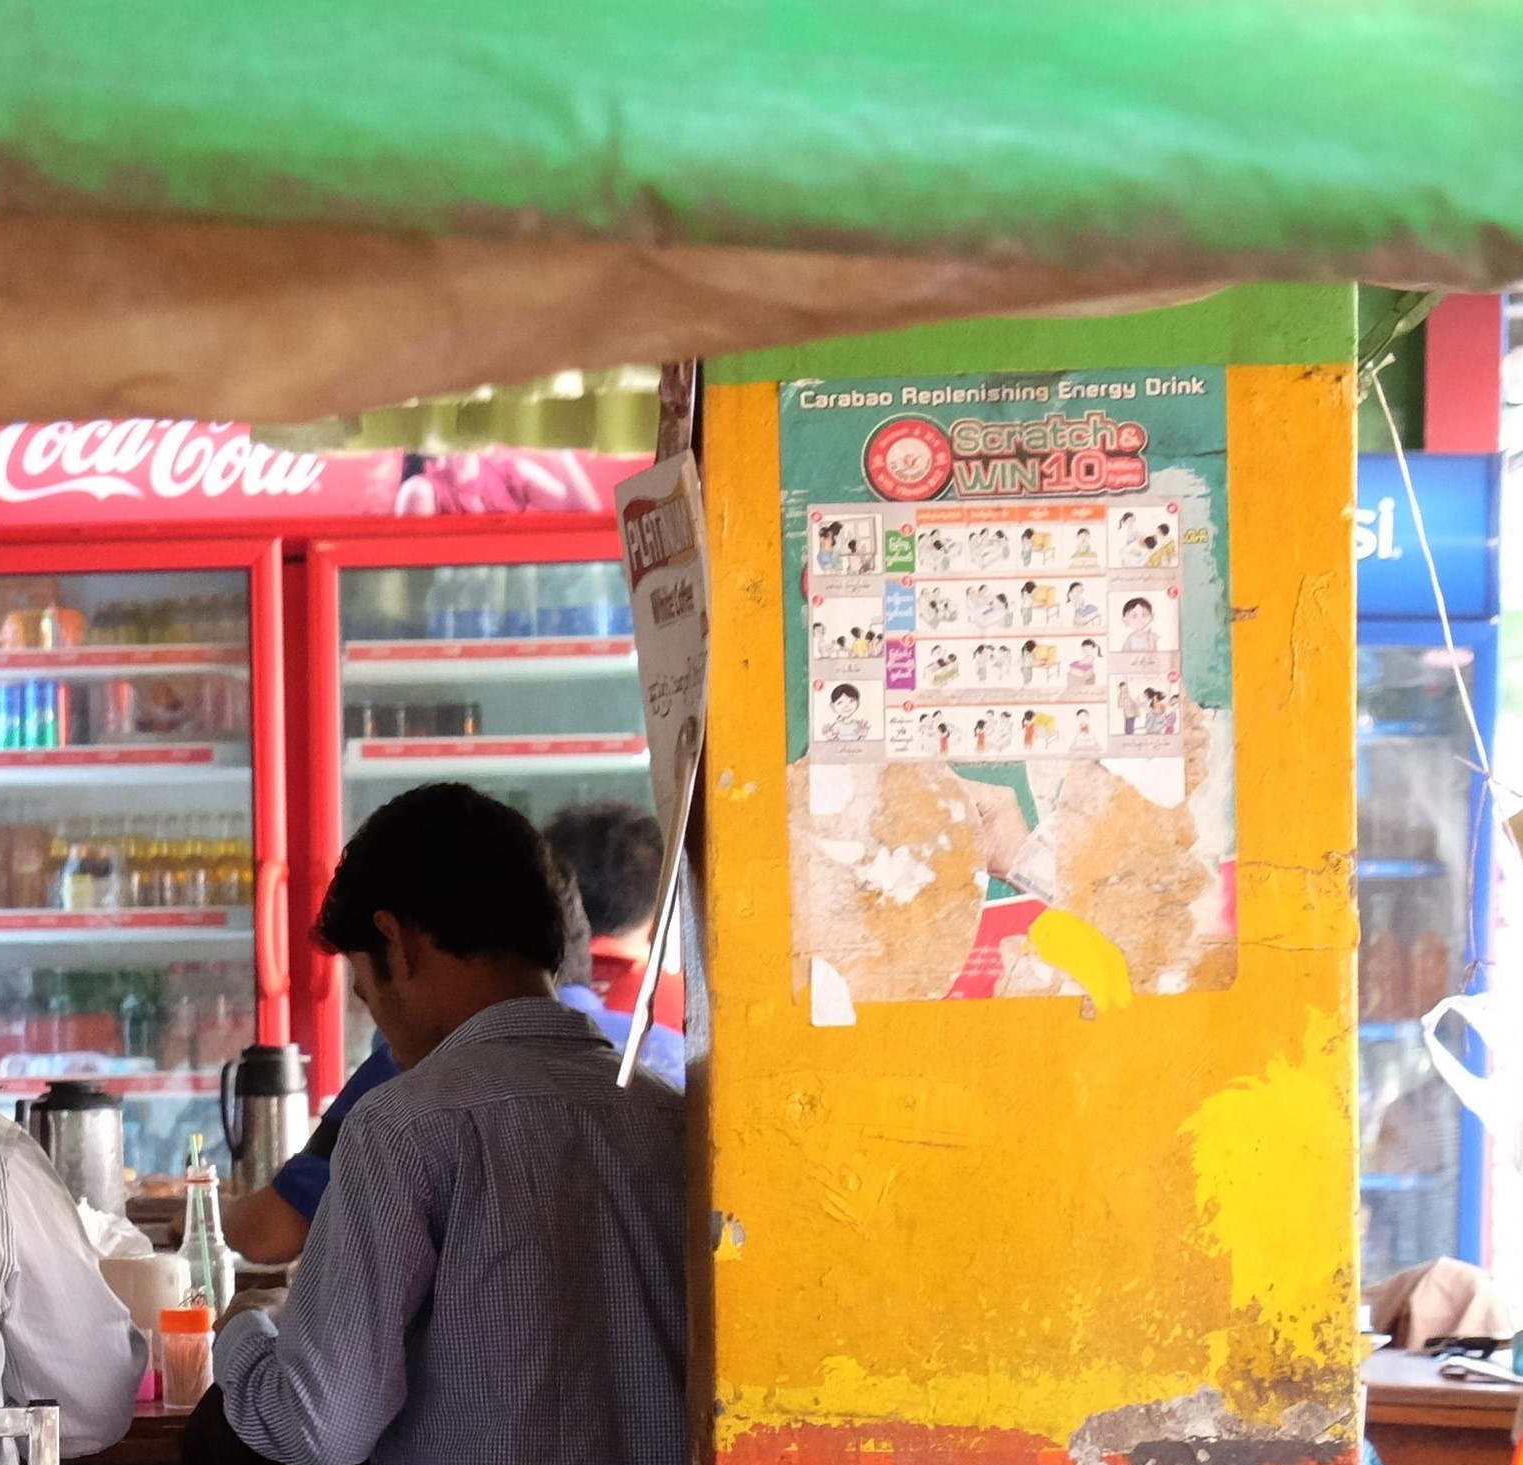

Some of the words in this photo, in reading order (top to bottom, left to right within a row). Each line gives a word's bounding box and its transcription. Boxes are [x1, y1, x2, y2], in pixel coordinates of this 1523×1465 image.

[800, 390, 893, 410] Carabao
[902, 383, 1050, 408] Replenishing
[1058, 380, 1136, 402] Energy
[1145, 376, 1206, 397] Drink
[954, 413, 1115, 453] Scratch
[954, 455, 1040, 495] WIN
[1041, 449, 1107, 492] 10
